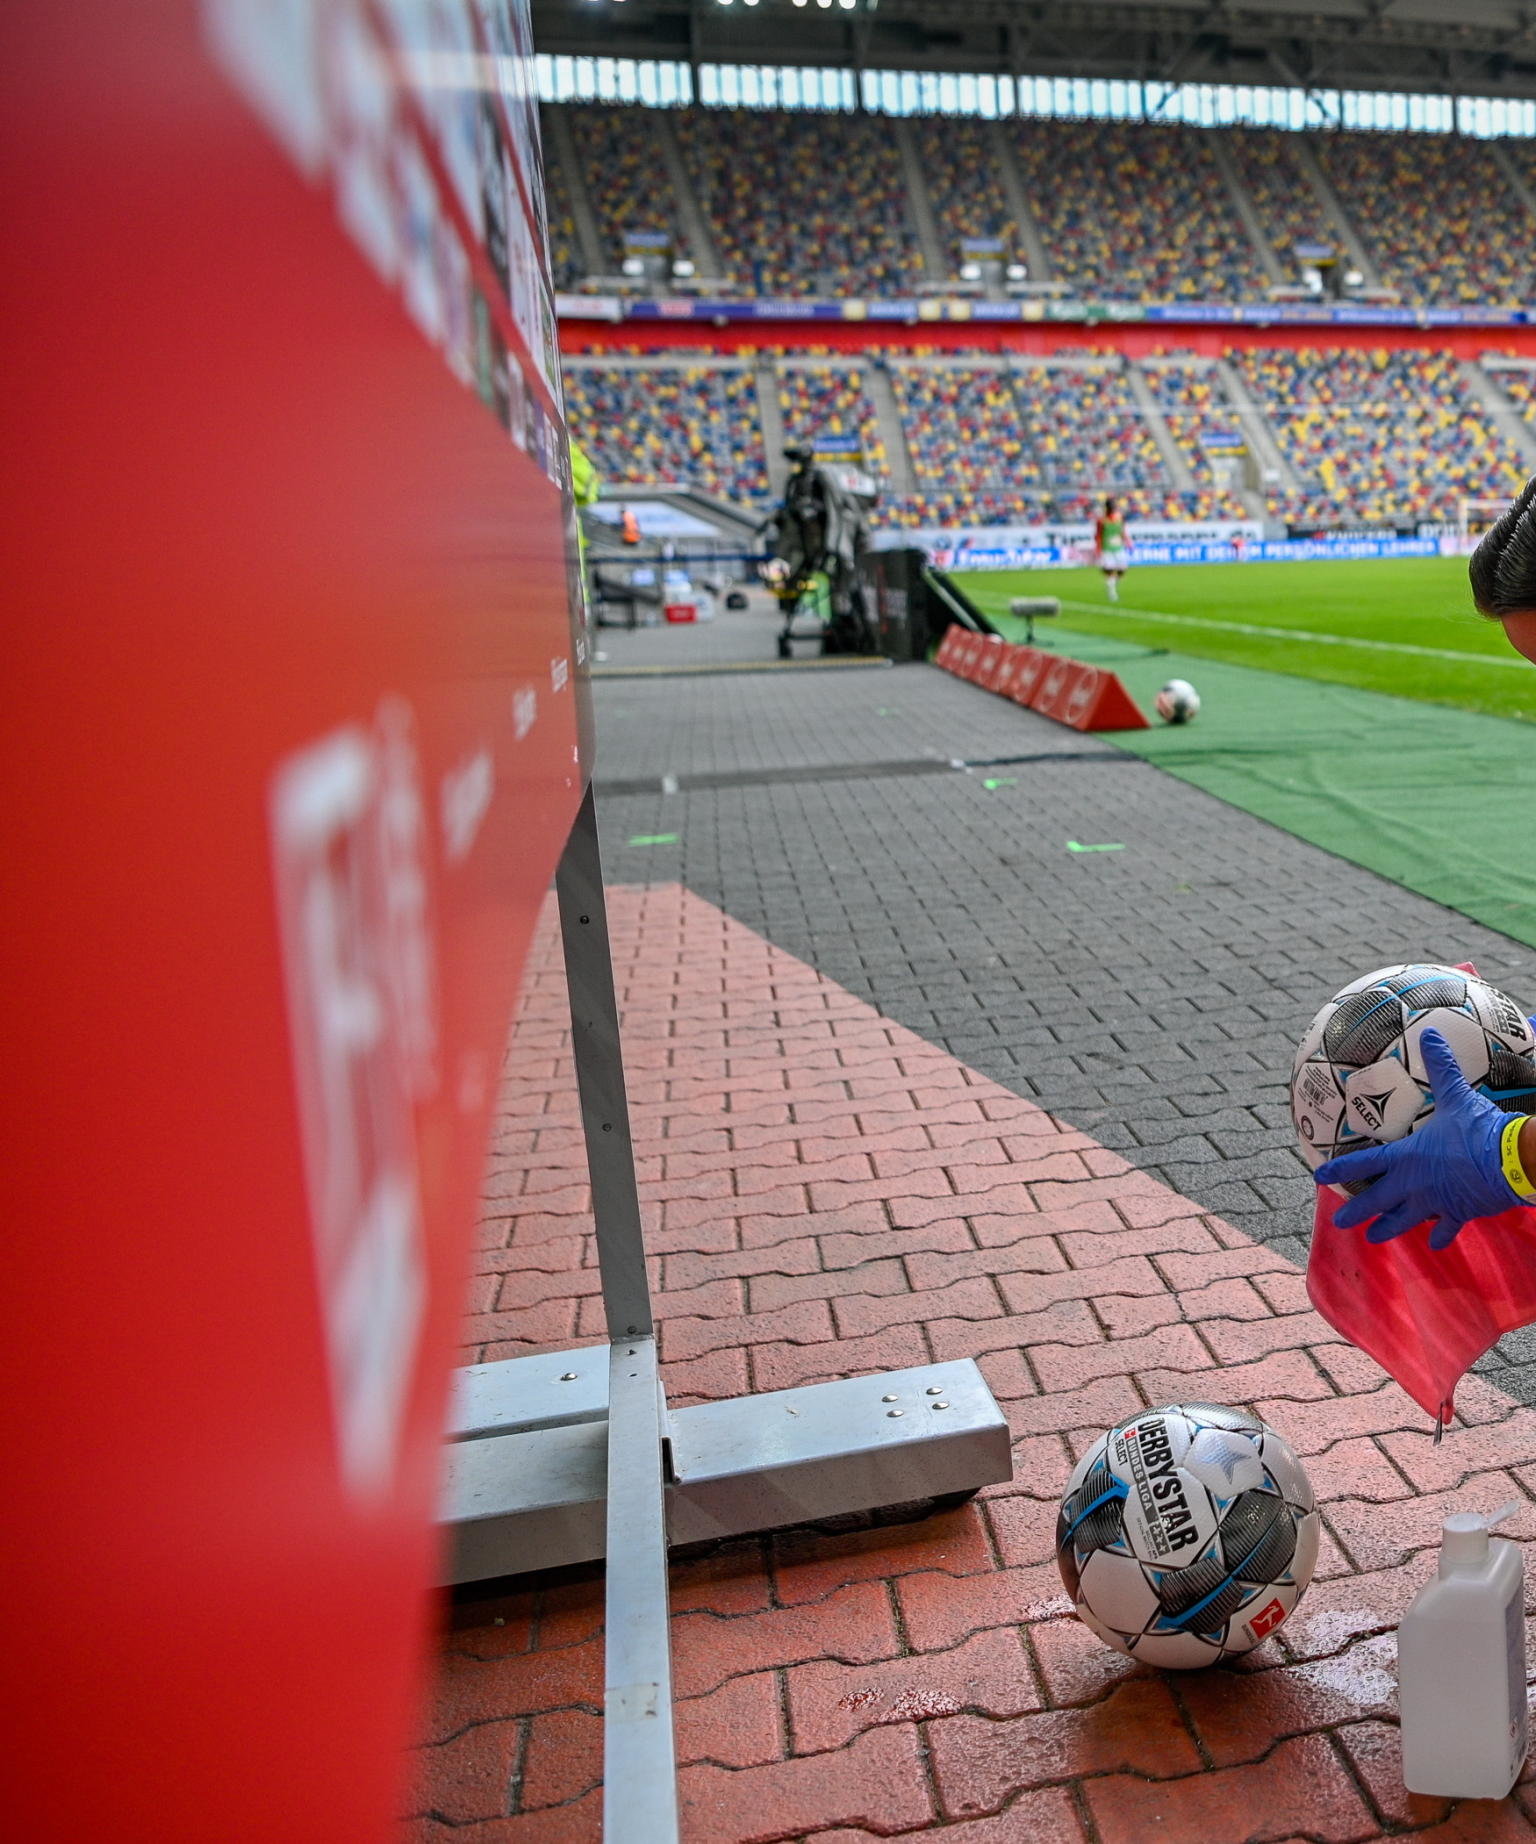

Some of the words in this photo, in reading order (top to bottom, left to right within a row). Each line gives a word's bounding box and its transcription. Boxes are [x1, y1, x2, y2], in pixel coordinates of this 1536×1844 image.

[1351, 1096, 1382, 1131] SELECT
[1115, 1438, 1128, 1467] SELECT
[1138, 1417, 1200, 1552] DERBYSTAR
